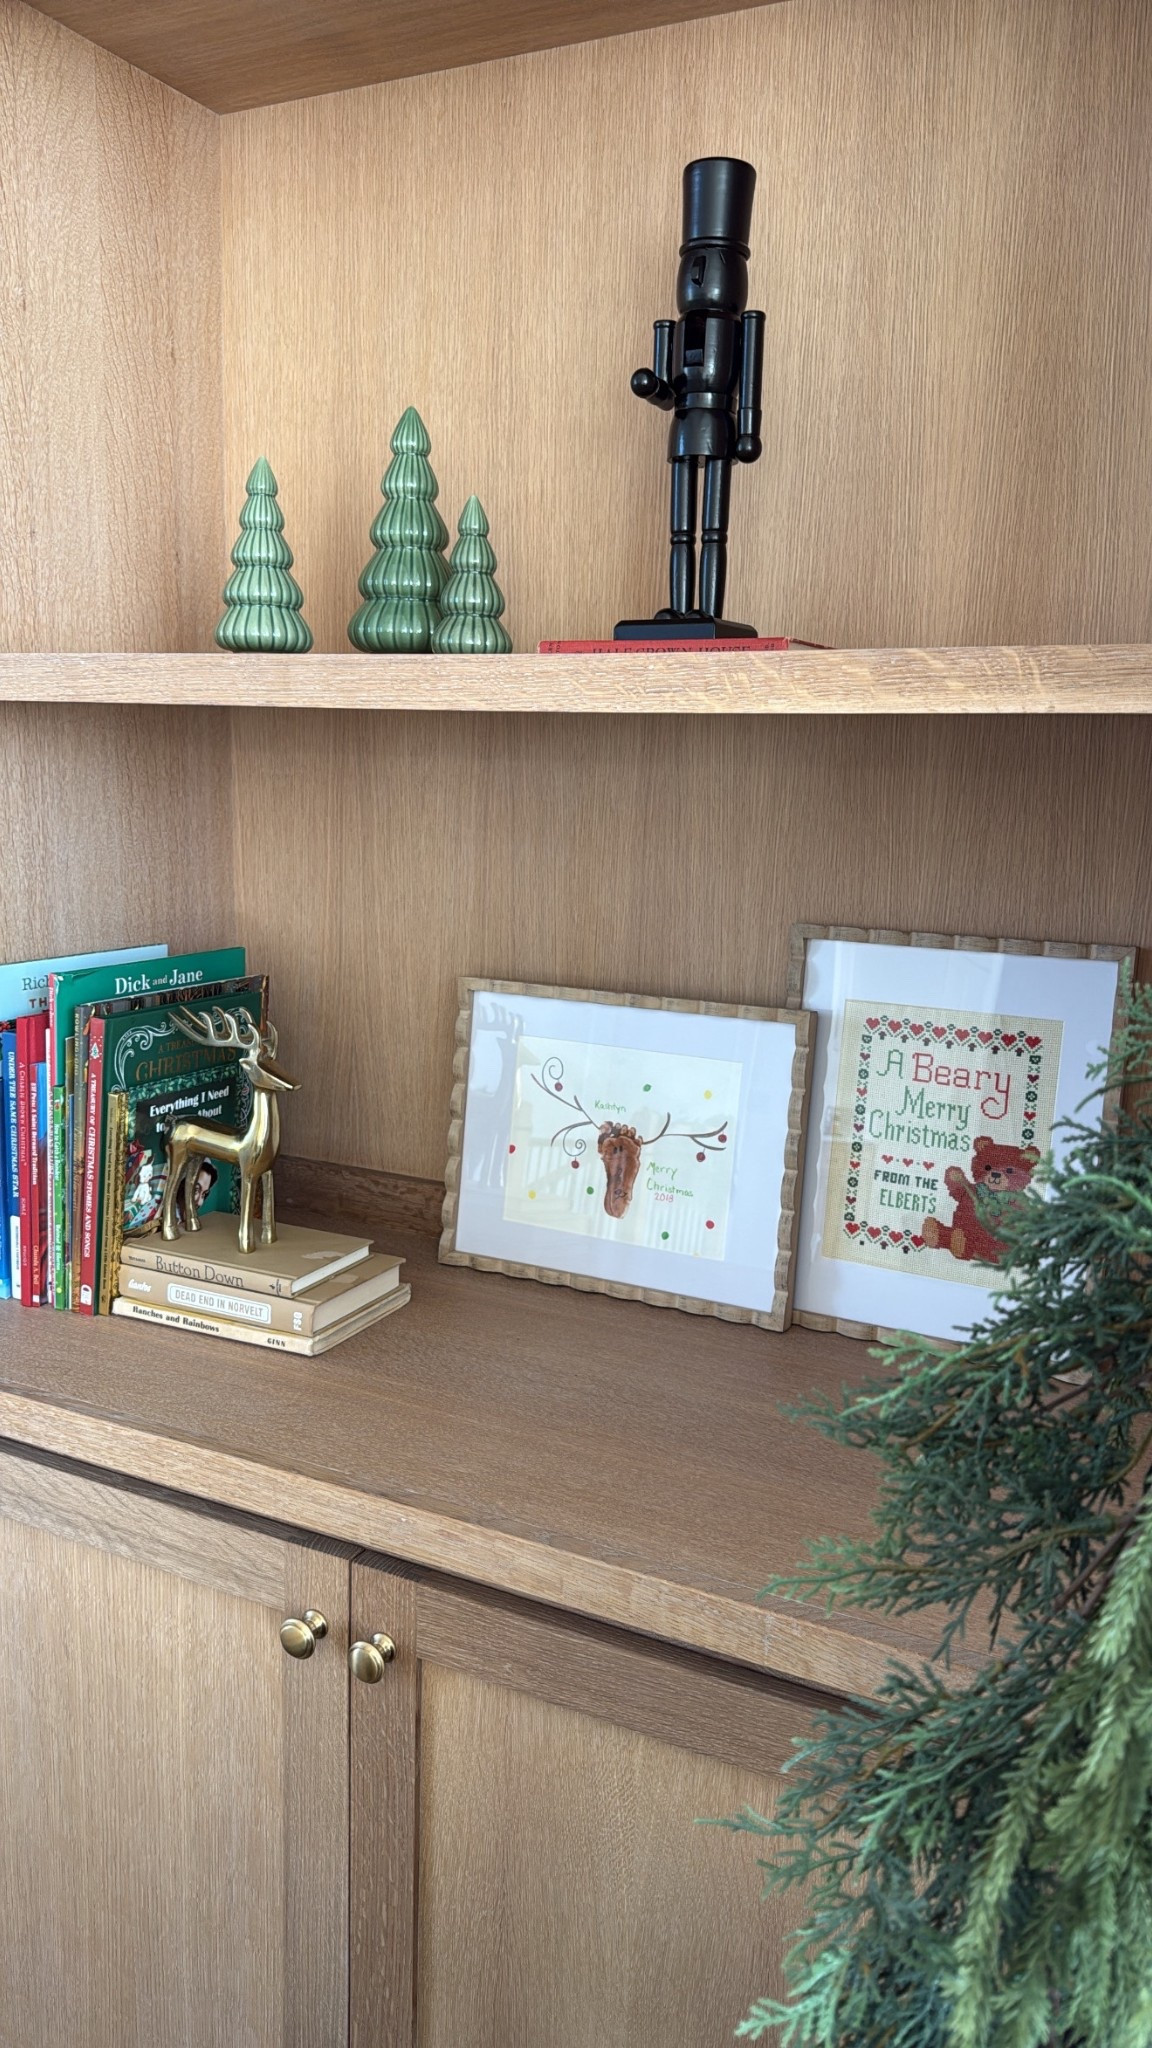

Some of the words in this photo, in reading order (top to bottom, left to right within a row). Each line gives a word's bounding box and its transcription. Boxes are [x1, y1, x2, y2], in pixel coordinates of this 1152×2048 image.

[114, 975, 151, 995] Dick
[152, 975, 168, 986] and
[169, 969, 203, 986] Jane
[29, 998, 49, 1009] TH
[135, 1048, 236, 1082] CHRISTMAS
[876, 1049, 903, 1079] A
[912, 1052, 1011, 1119] Beary
[150, 1094, 199, 1117] Everything
[201, 1093, 206, 1103] I
[207, 1086, 230, 1100] Need
[895, 1085, 971, 1131] Merry
[90, 1115, 95, 1125] OF
[156, 1122, 165, 1133] to
[869, 1109, 971, 1152] Christmas
[10, 1125, 18, 1173] CHRISTMAS
[87, 1126, 96, 1180] CHRISTMAS
[647, 1161, 678, 1180] Merry
[874, 1169, 910, 1186] FROM
[915, 1176, 939, 1191] THE
[647, 1177, 693, 1197] Christmas
[156, 1255, 201, 1279] Button
[204, 1265, 245, 1287] Down
[175, 1289, 196, 1303] DEAD
[200, 1294, 214, 1306] END
[217, 1297, 225, 1309] IN
[228, 1299, 263, 1318] NORVELT
[133, 1305, 163, 1320] Ranches
[166, 1313, 180, 1324] and
[183, 1317, 219, 1333] Rainbows
[267, 1338, 285, 1347] GINN
